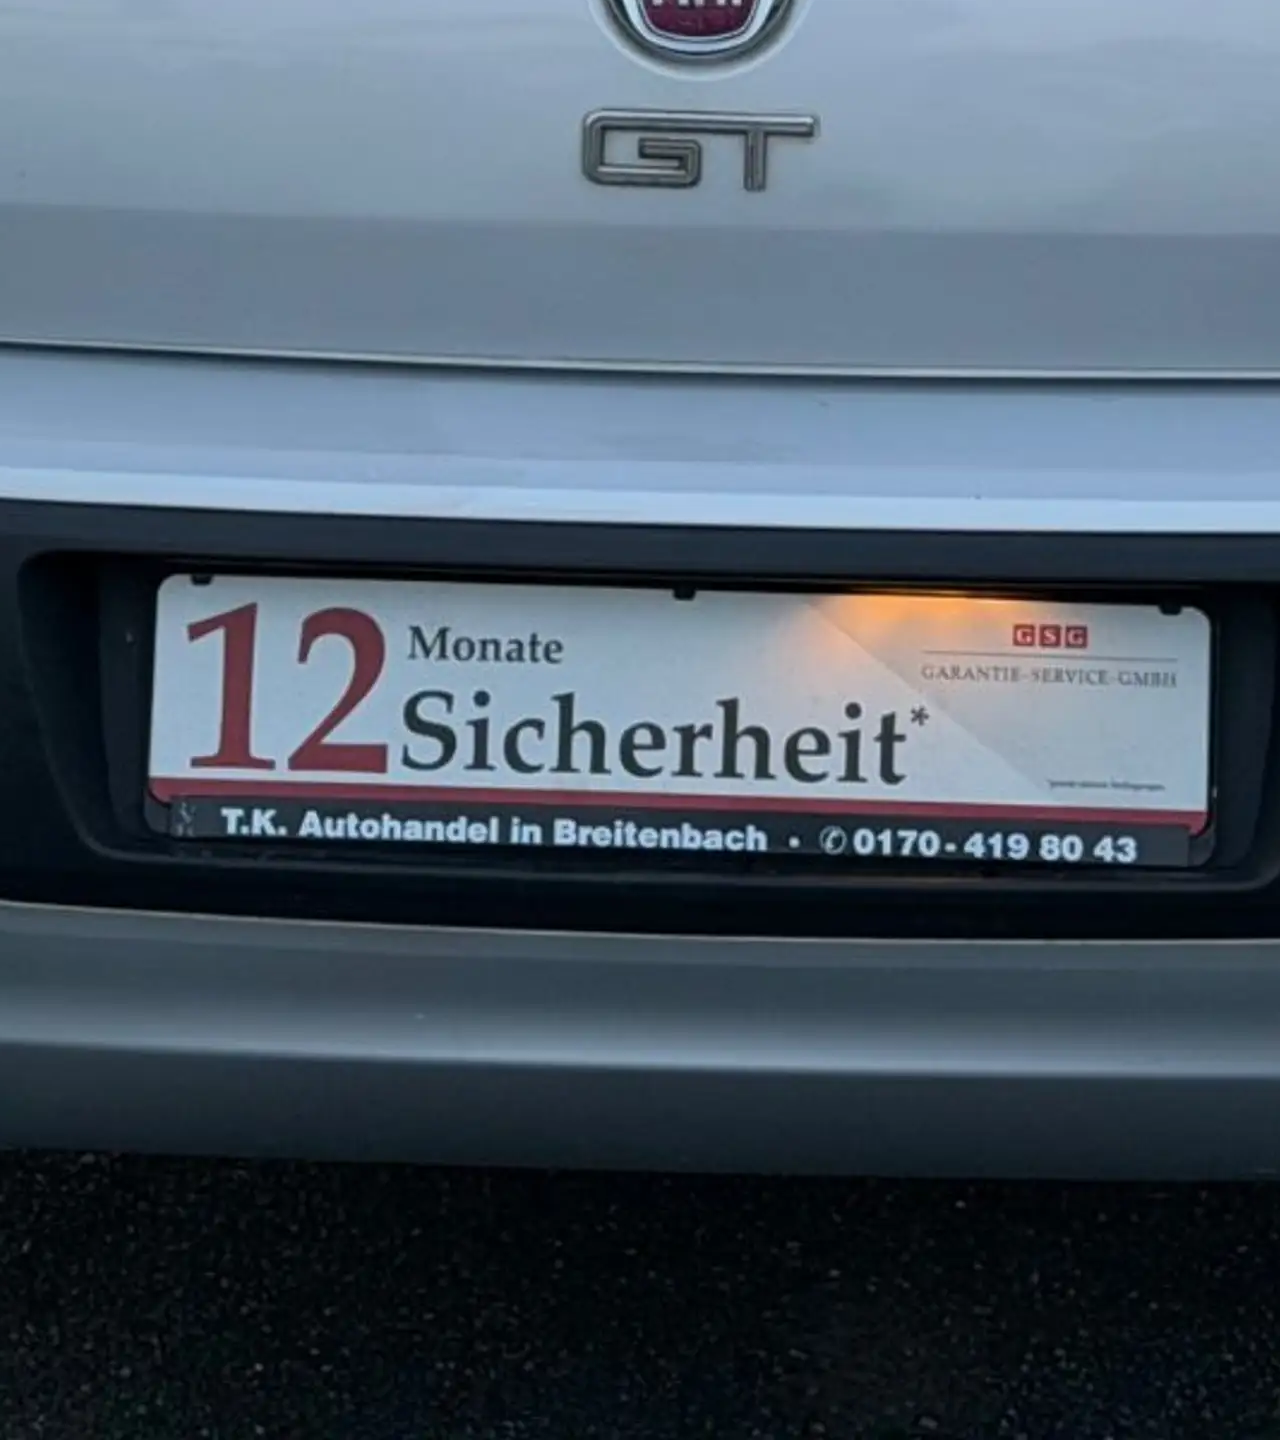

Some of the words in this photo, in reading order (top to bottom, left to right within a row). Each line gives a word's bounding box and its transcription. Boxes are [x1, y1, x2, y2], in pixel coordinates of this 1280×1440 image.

[583, 109, 819, 192] GT
[408, 624, 564, 664] Monate
[1013, 624, 1088, 649] GSG
[187, 602, 388, 774] 12
[220, 807, 287, 837] T.K.
[299, 810, 500, 844] Autohandel
[510, 817, 542, 846] in
[553, 819, 767, 853] Breitenbach
[1038, 834, 1084, 862] 80
[1093, 835, 1138, 864] 43
